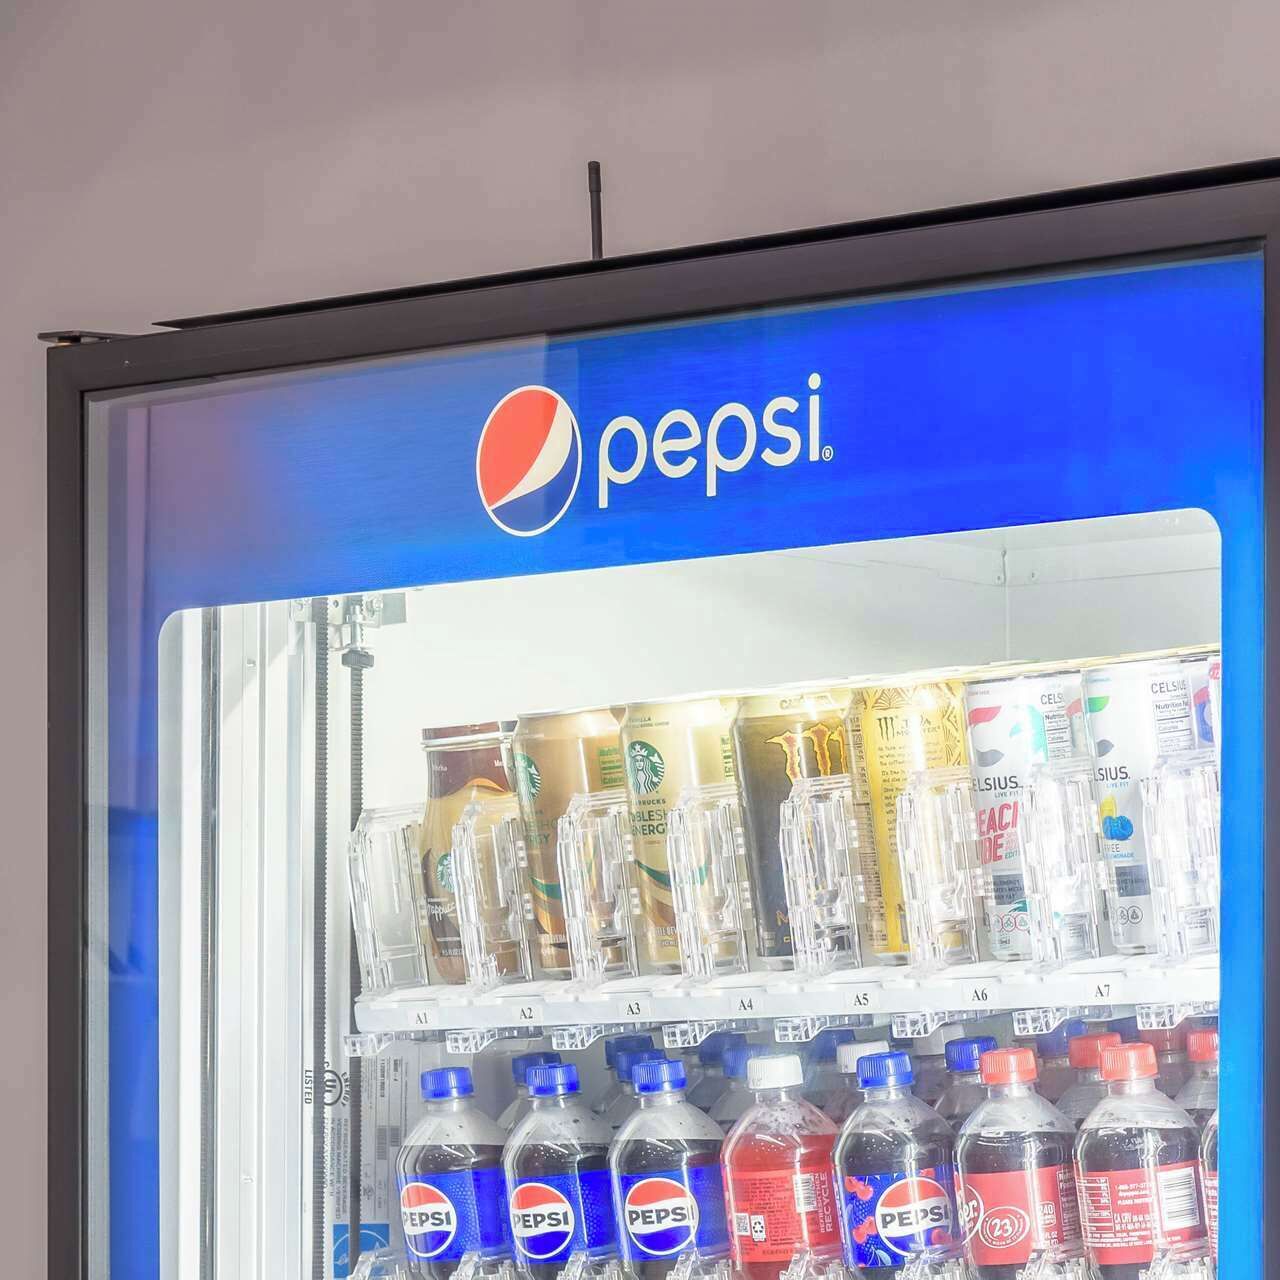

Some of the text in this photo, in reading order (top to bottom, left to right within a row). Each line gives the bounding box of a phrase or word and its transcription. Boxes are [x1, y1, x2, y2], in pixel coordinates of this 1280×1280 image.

[598, 372, 820, 509] pepsi
[853, 993, 869, 1007] A5
[1094, 984, 1110, 998] A7
[519, 1006, 533, 1020] A2
[403, 1209, 452, 1228] PEPSI
[512, 1208, 569, 1229] PEPSI
[629, 1207, 694, 1227] PEPSI
[881, 1205, 949, 1229] PEPSI
[992, 1217, 1014, 1237] 23
